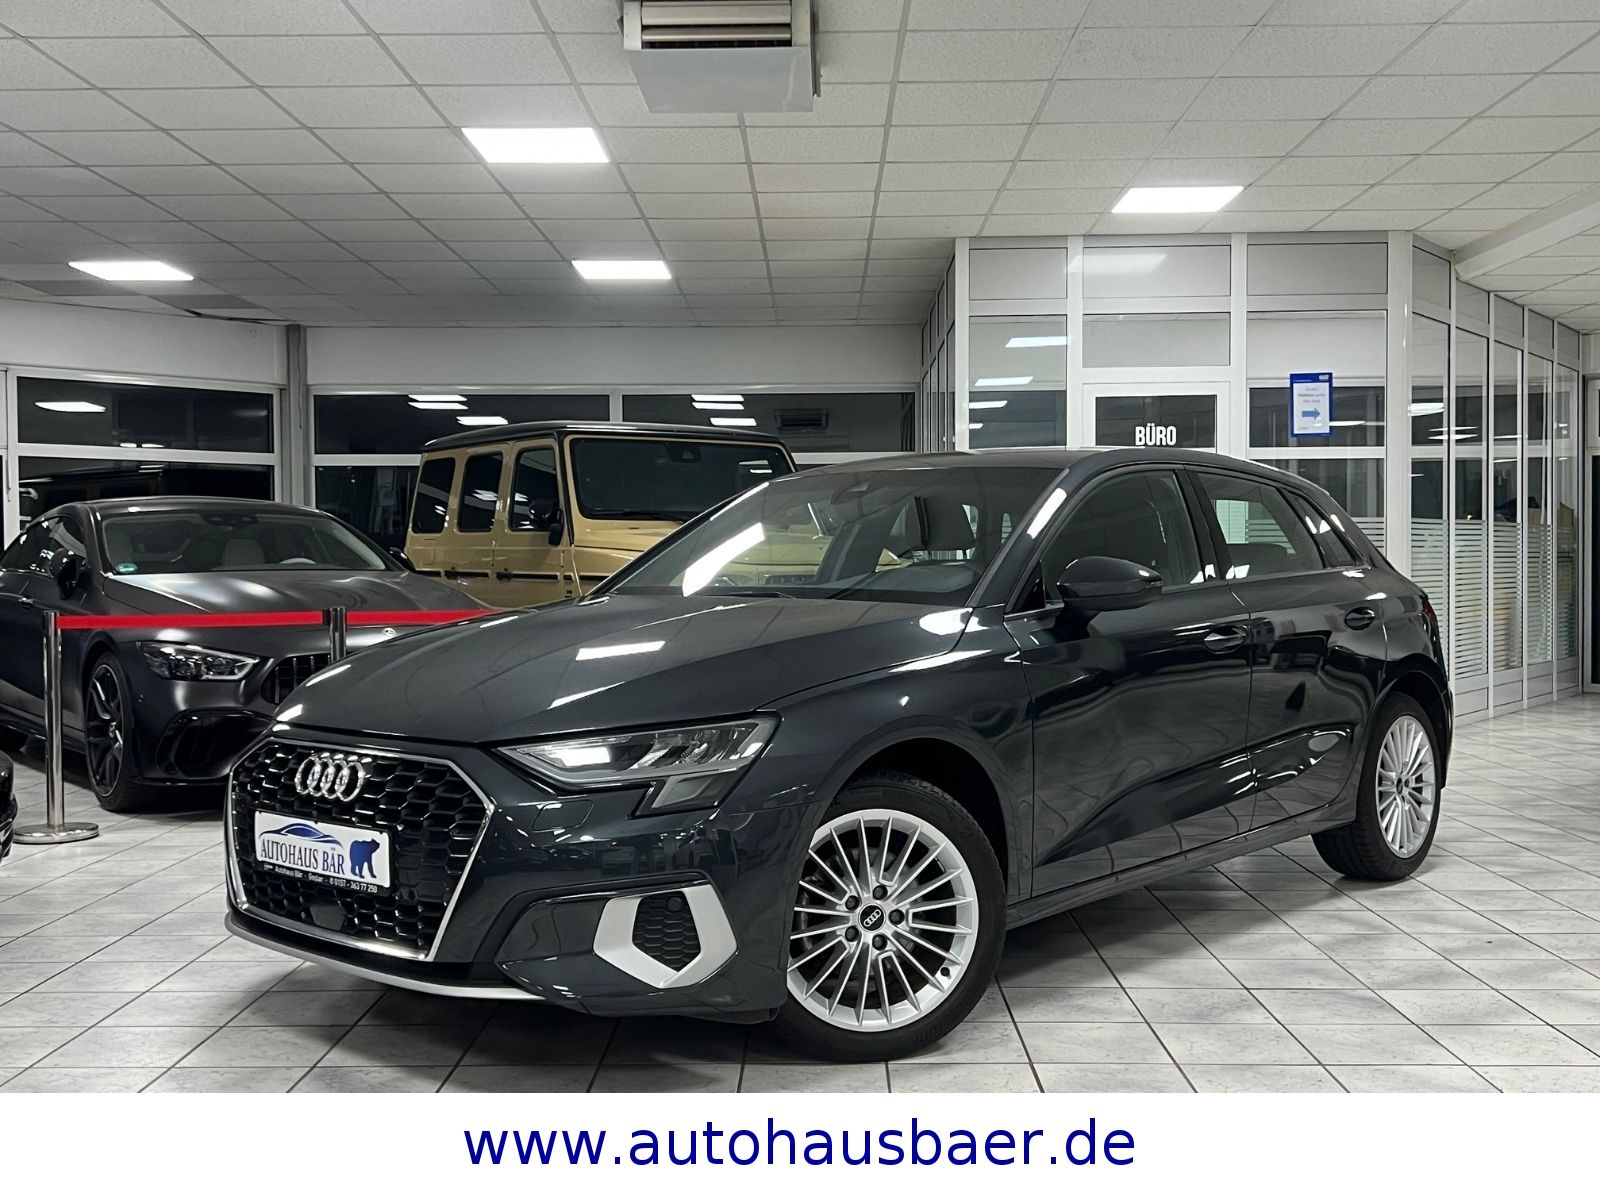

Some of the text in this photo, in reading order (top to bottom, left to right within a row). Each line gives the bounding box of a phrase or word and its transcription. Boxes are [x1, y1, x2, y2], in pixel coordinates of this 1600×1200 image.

[1135, 422, 1177, 446] BÜRO
[260, 838, 345, 875] AUTOHAUS BÄR
[360, 883, 368, 892] 77
